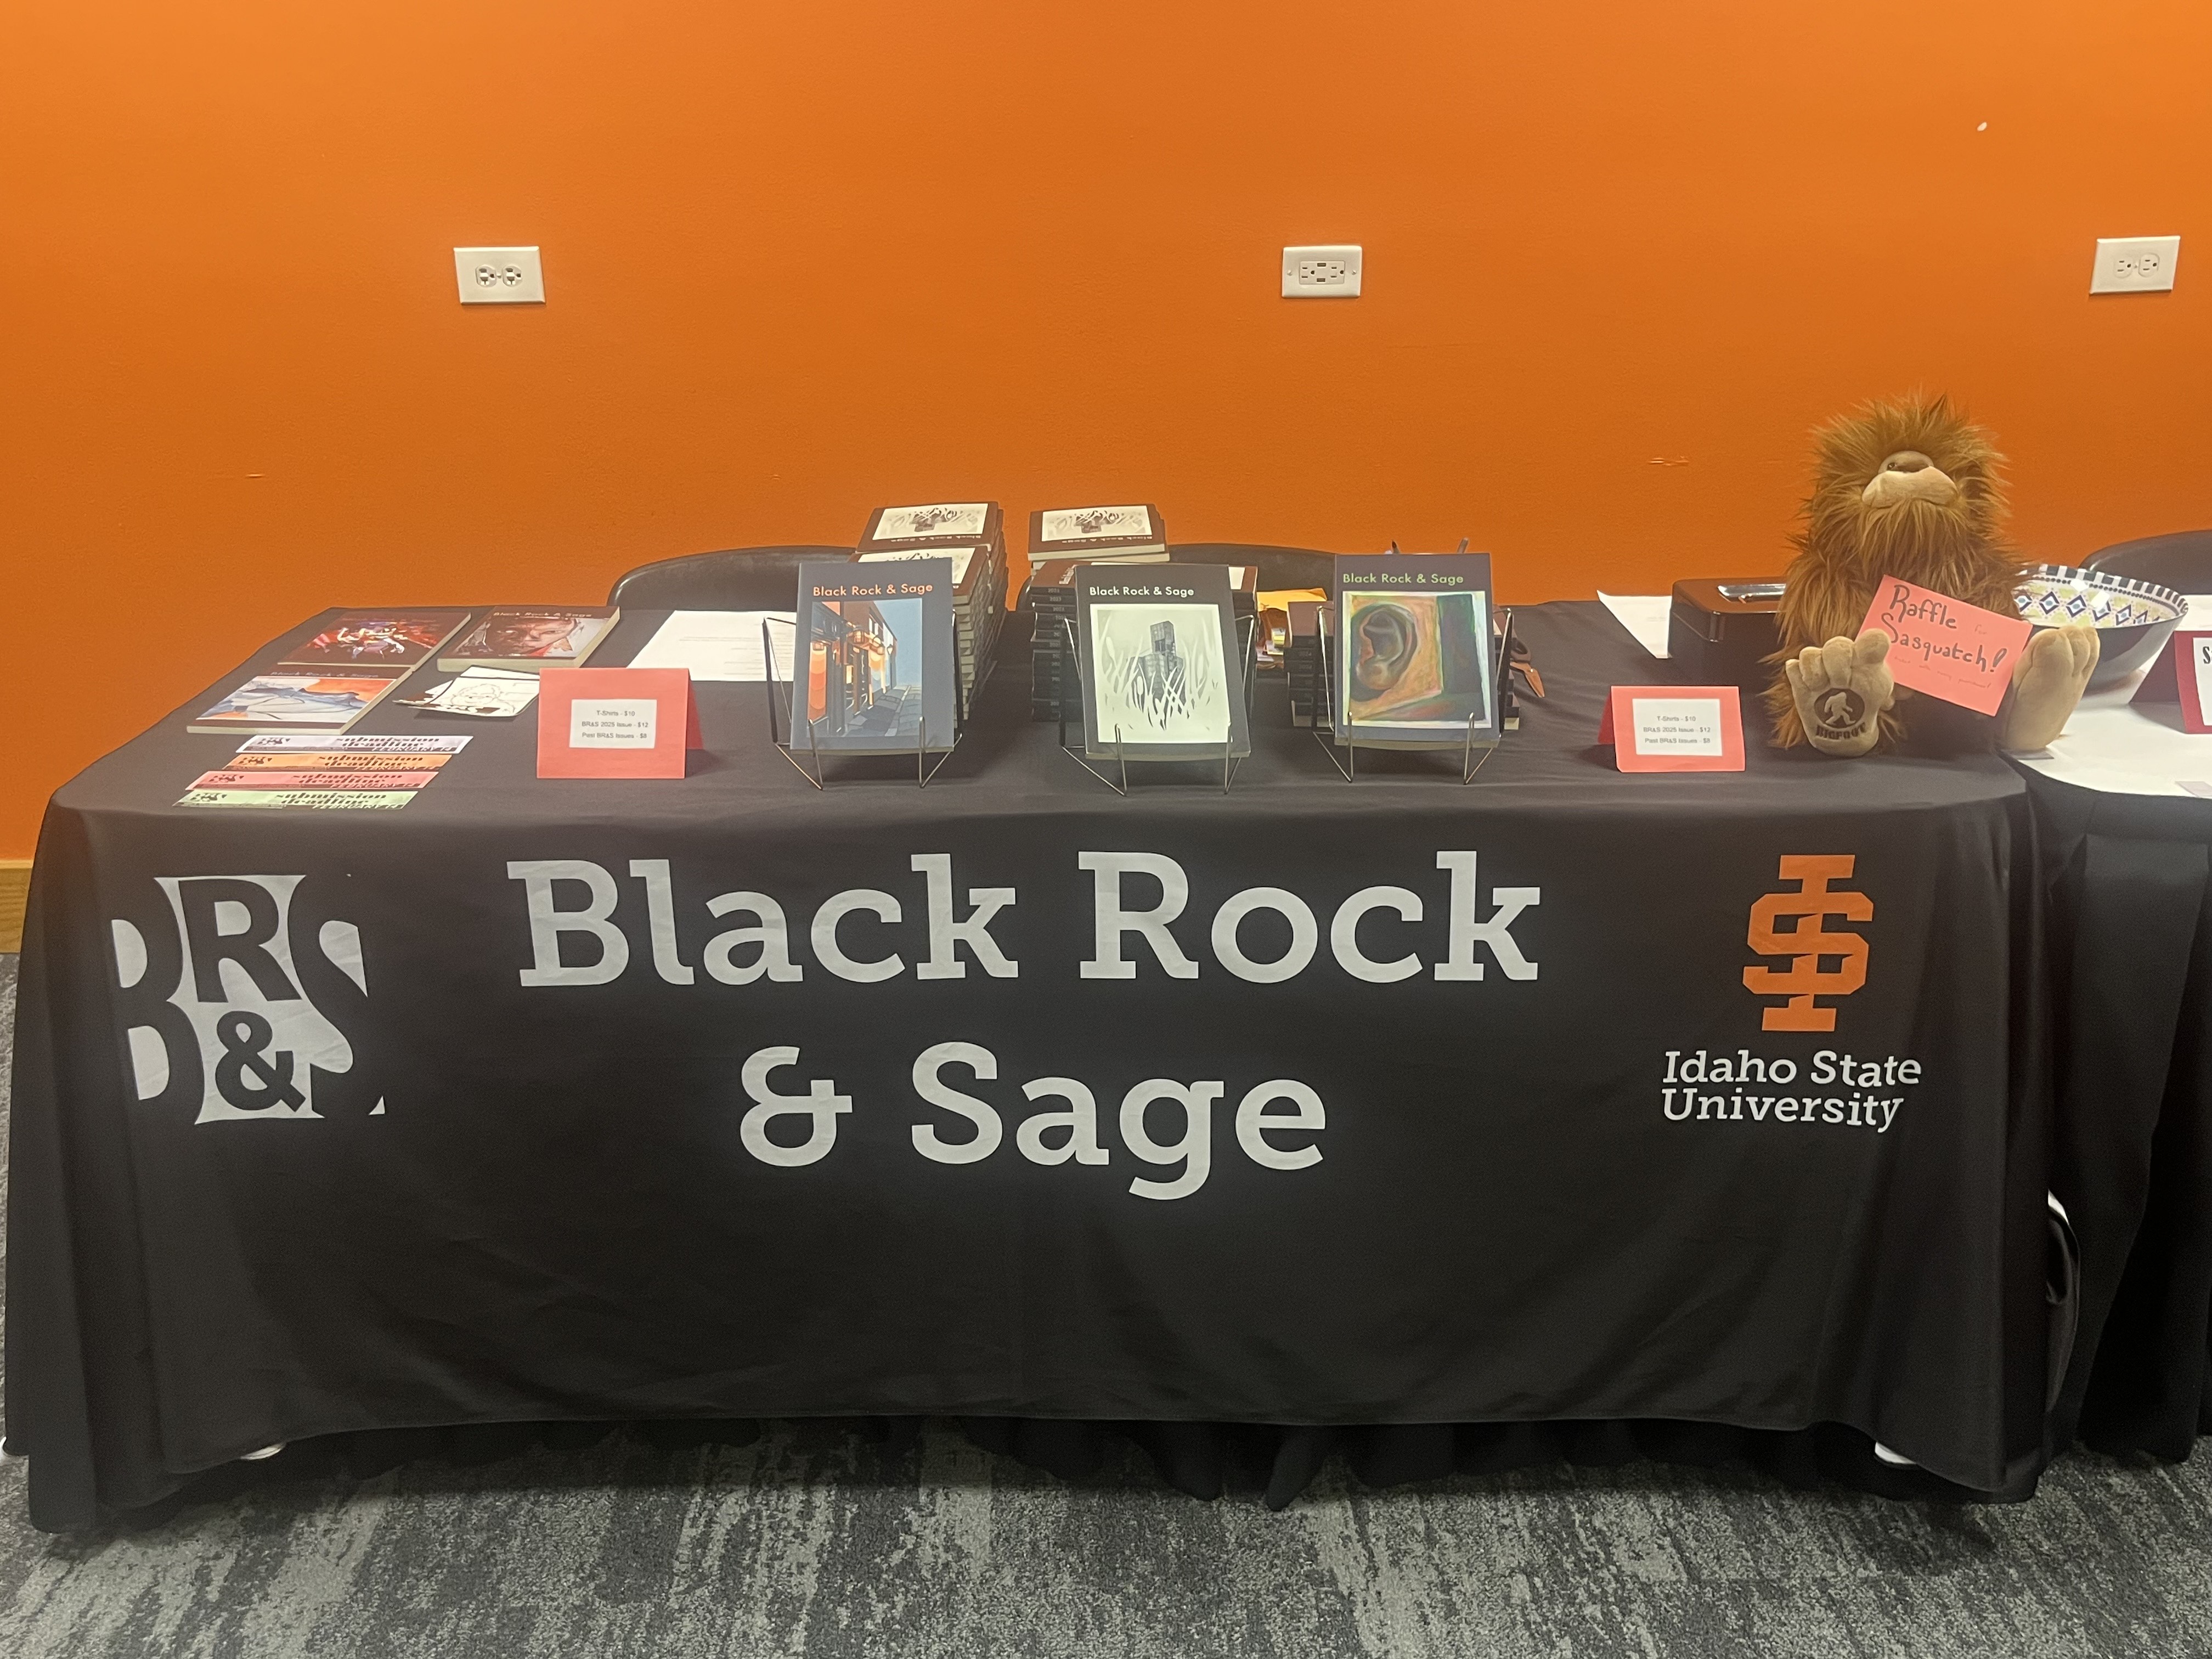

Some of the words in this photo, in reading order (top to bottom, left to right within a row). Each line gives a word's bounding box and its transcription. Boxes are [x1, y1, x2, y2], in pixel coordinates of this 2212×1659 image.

[812, 585, 847, 596] Black
[851, 584, 882, 596] Rock
[886, 584, 896, 594] &
[900, 583, 933, 595] Sage
[1090, 586, 1120, 596] Black
[1122, 586, 1150, 596] Rock
[1153, 586, 1162, 596] &
[1165, 586, 1194, 598] Sage
[1342, 573, 1377, 583] Black
[1381, 573, 1412, 583] Rock
[1417, 573, 1426, 583] &
[1431, 574, 1464, 586] Sage
[1889, 584, 1957, 629] Raffle
[1881, 612, 2007, 673] Sasquatch!
[1815, 722, 1866, 740] BIGFOOT
[506, 853, 1019, 987] Black
[1077, 850, 1541, 983] Rock
[1662, 1049, 1797, 1084] Idaho
[1810, 1050, 1922, 1087] State
[740, 1045, 853, 1167] &
[911, 1041, 1326, 1200] Sage
[1661, 1087, 1904, 1133] University
